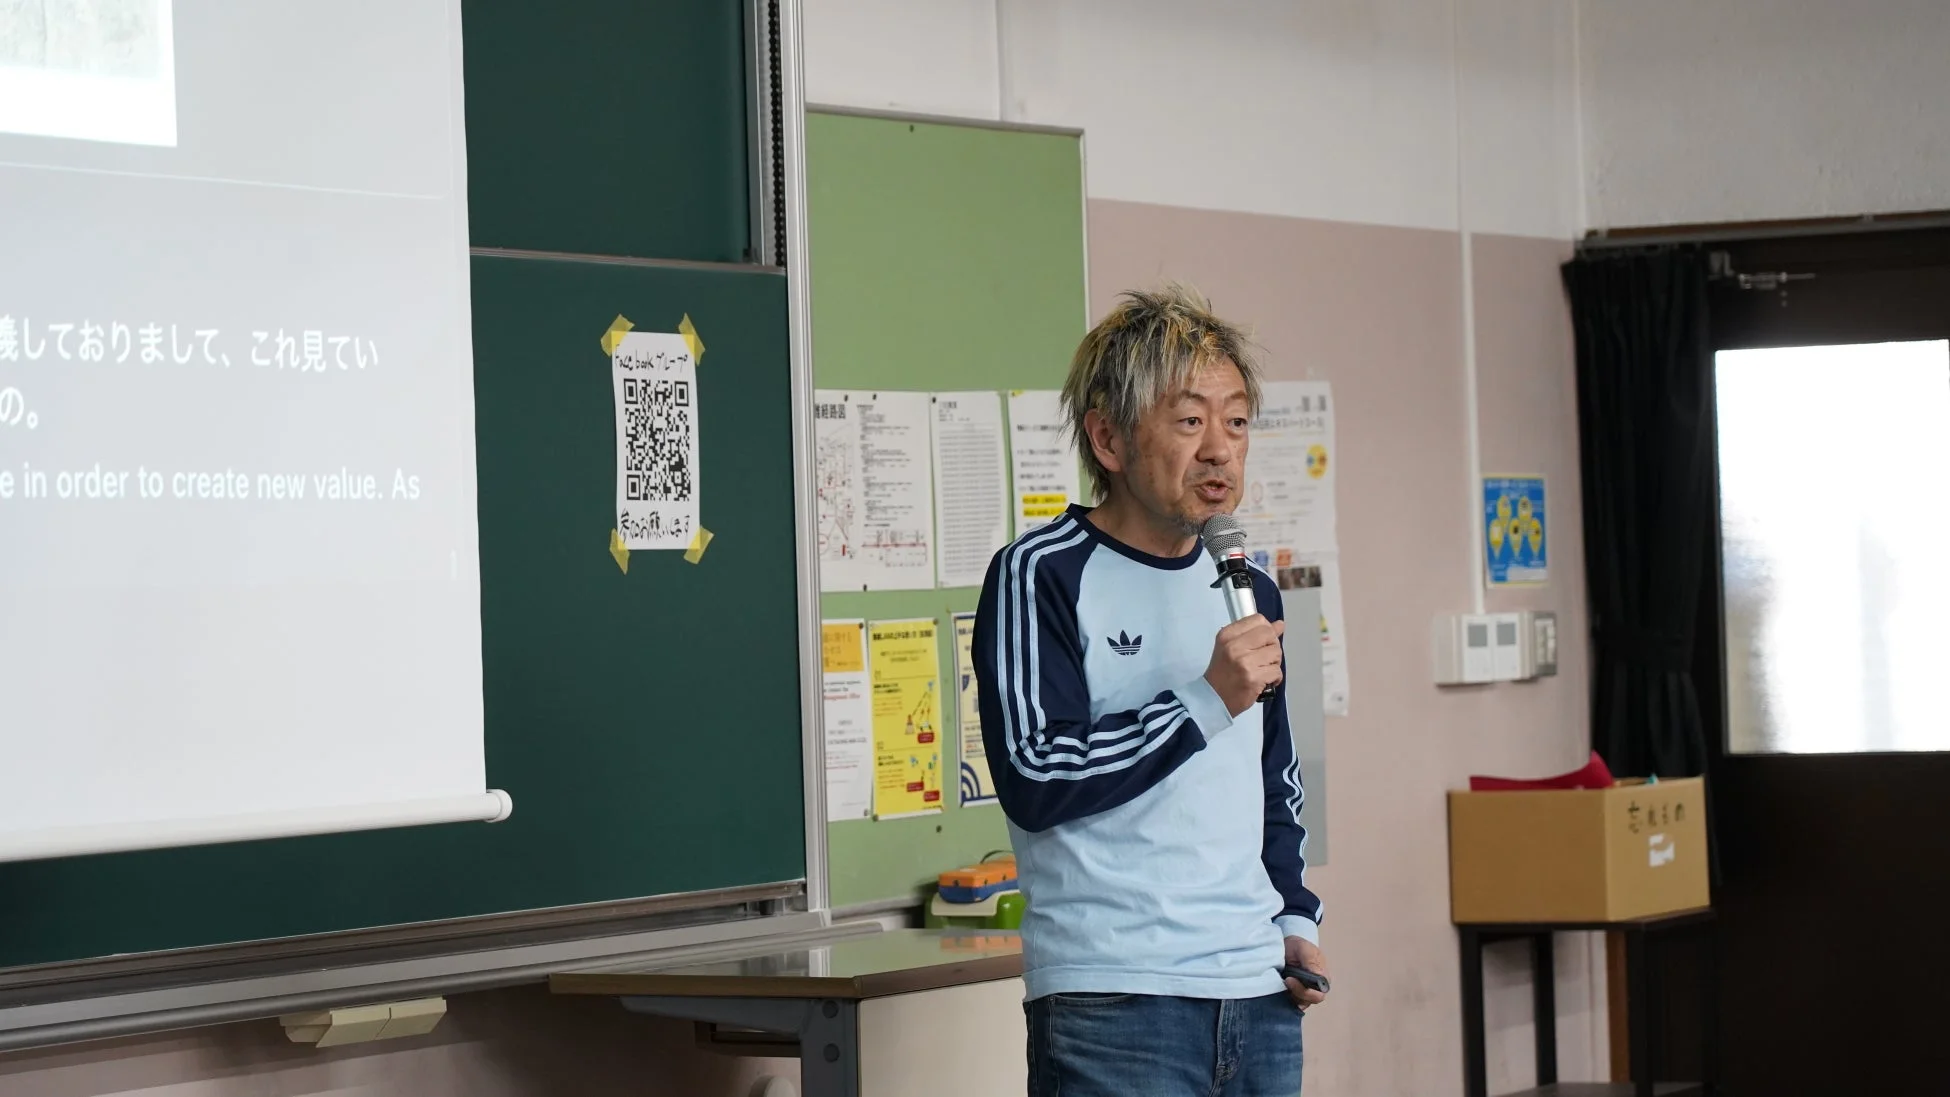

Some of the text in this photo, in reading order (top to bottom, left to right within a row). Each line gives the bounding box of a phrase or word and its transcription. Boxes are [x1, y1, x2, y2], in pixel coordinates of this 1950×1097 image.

[23, 461, 48, 499] in
[56, 462, 129, 500] order
[137, 466, 165, 499] to
[172, 467, 250, 500] create
[258, 473, 306, 500] new
[313, 466, 384, 500] value.
[392, 467, 421, 500] As
